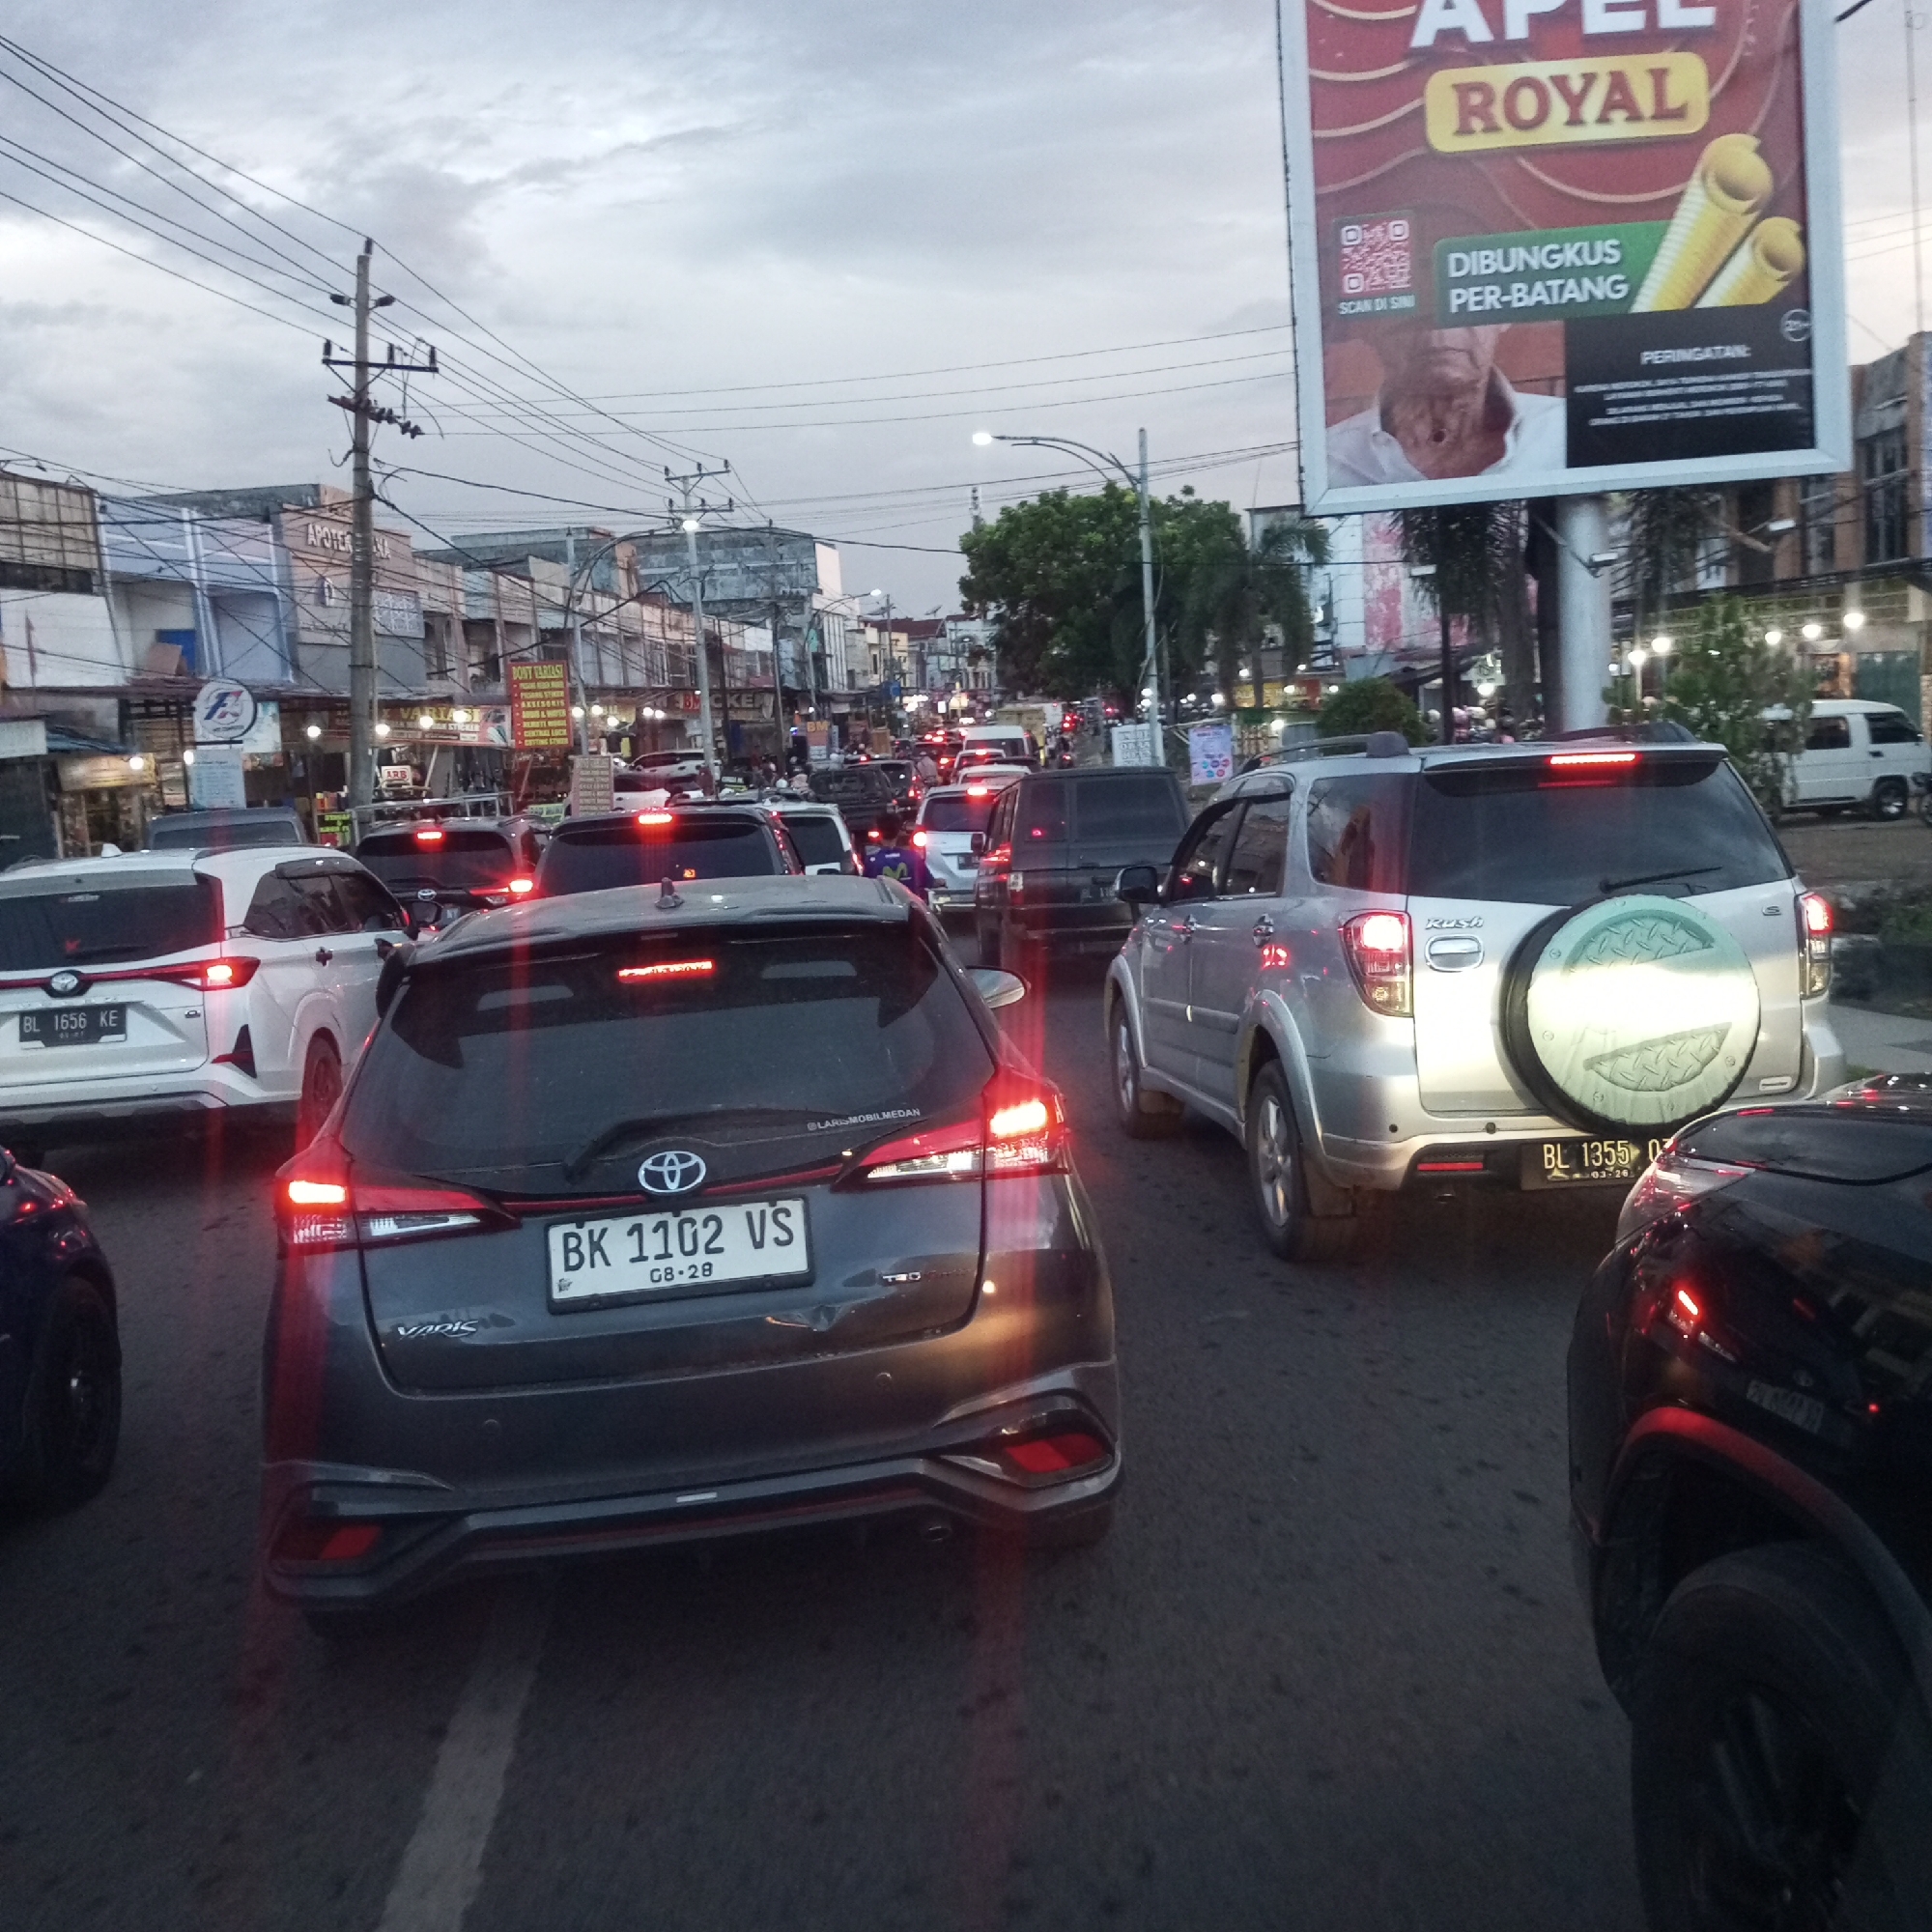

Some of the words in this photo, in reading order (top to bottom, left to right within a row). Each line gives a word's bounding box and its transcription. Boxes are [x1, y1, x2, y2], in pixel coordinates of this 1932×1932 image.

[1451, 67, 1689, 135] ROYAL
[1449, 239, 1621, 278] DIBUNGKUS
[1339, 299, 1373, 315] SCAN
[1374, 298, 1388, 311] DI
[1450, 273, 1629, 313] PER-BATANG
[386, 770, 408, 780] ARB
[1425, 916, 1484, 930] Rush
[22, 1016, 42, 1034] BL
[53, 1012, 88, 1031] 1656
[99, 1009, 119, 1028] KE
[1543, 1143, 1570, 1169] BL
[1581, 1140, 1630, 1167] 1355
[562, 1227, 611, 1272] BK
[627, 1214, 724, 1264] 1102
[745, 1208, 794, 1250] VS
[398, 1320, 479, 1341] YARIS
